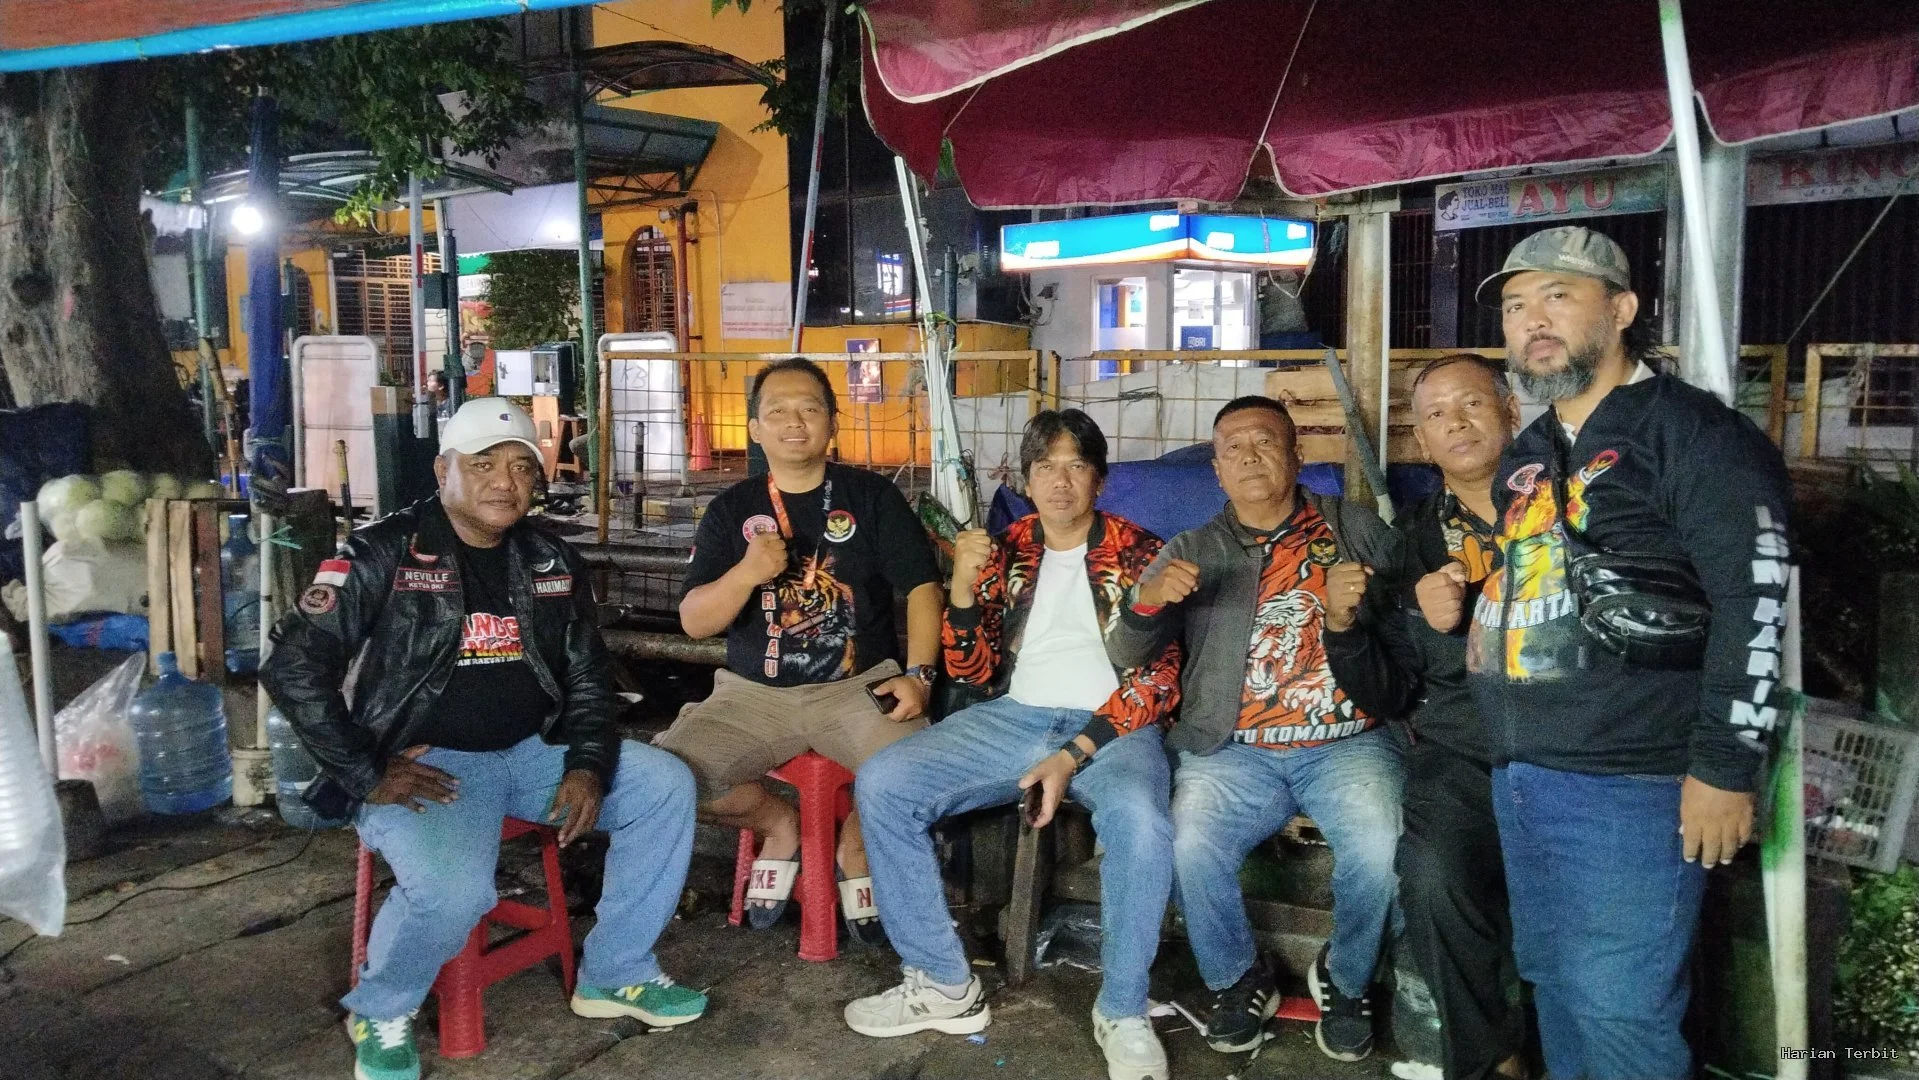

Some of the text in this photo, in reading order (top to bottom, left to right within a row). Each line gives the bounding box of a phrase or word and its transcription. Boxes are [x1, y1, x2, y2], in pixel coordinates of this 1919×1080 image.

[1462, 186, 1488, 198] TOKO
[1513, 177, 1616, 218] AYU
[1461, 195, 1509, 211] JUAL-BELI
[405, 571, 449, 582] NEVILLE
[1481, 588, 1577, 629] JAARTA
[1262, 718, 1368, 744] KOMANDO
[909, 1002, 930, 1016] N
